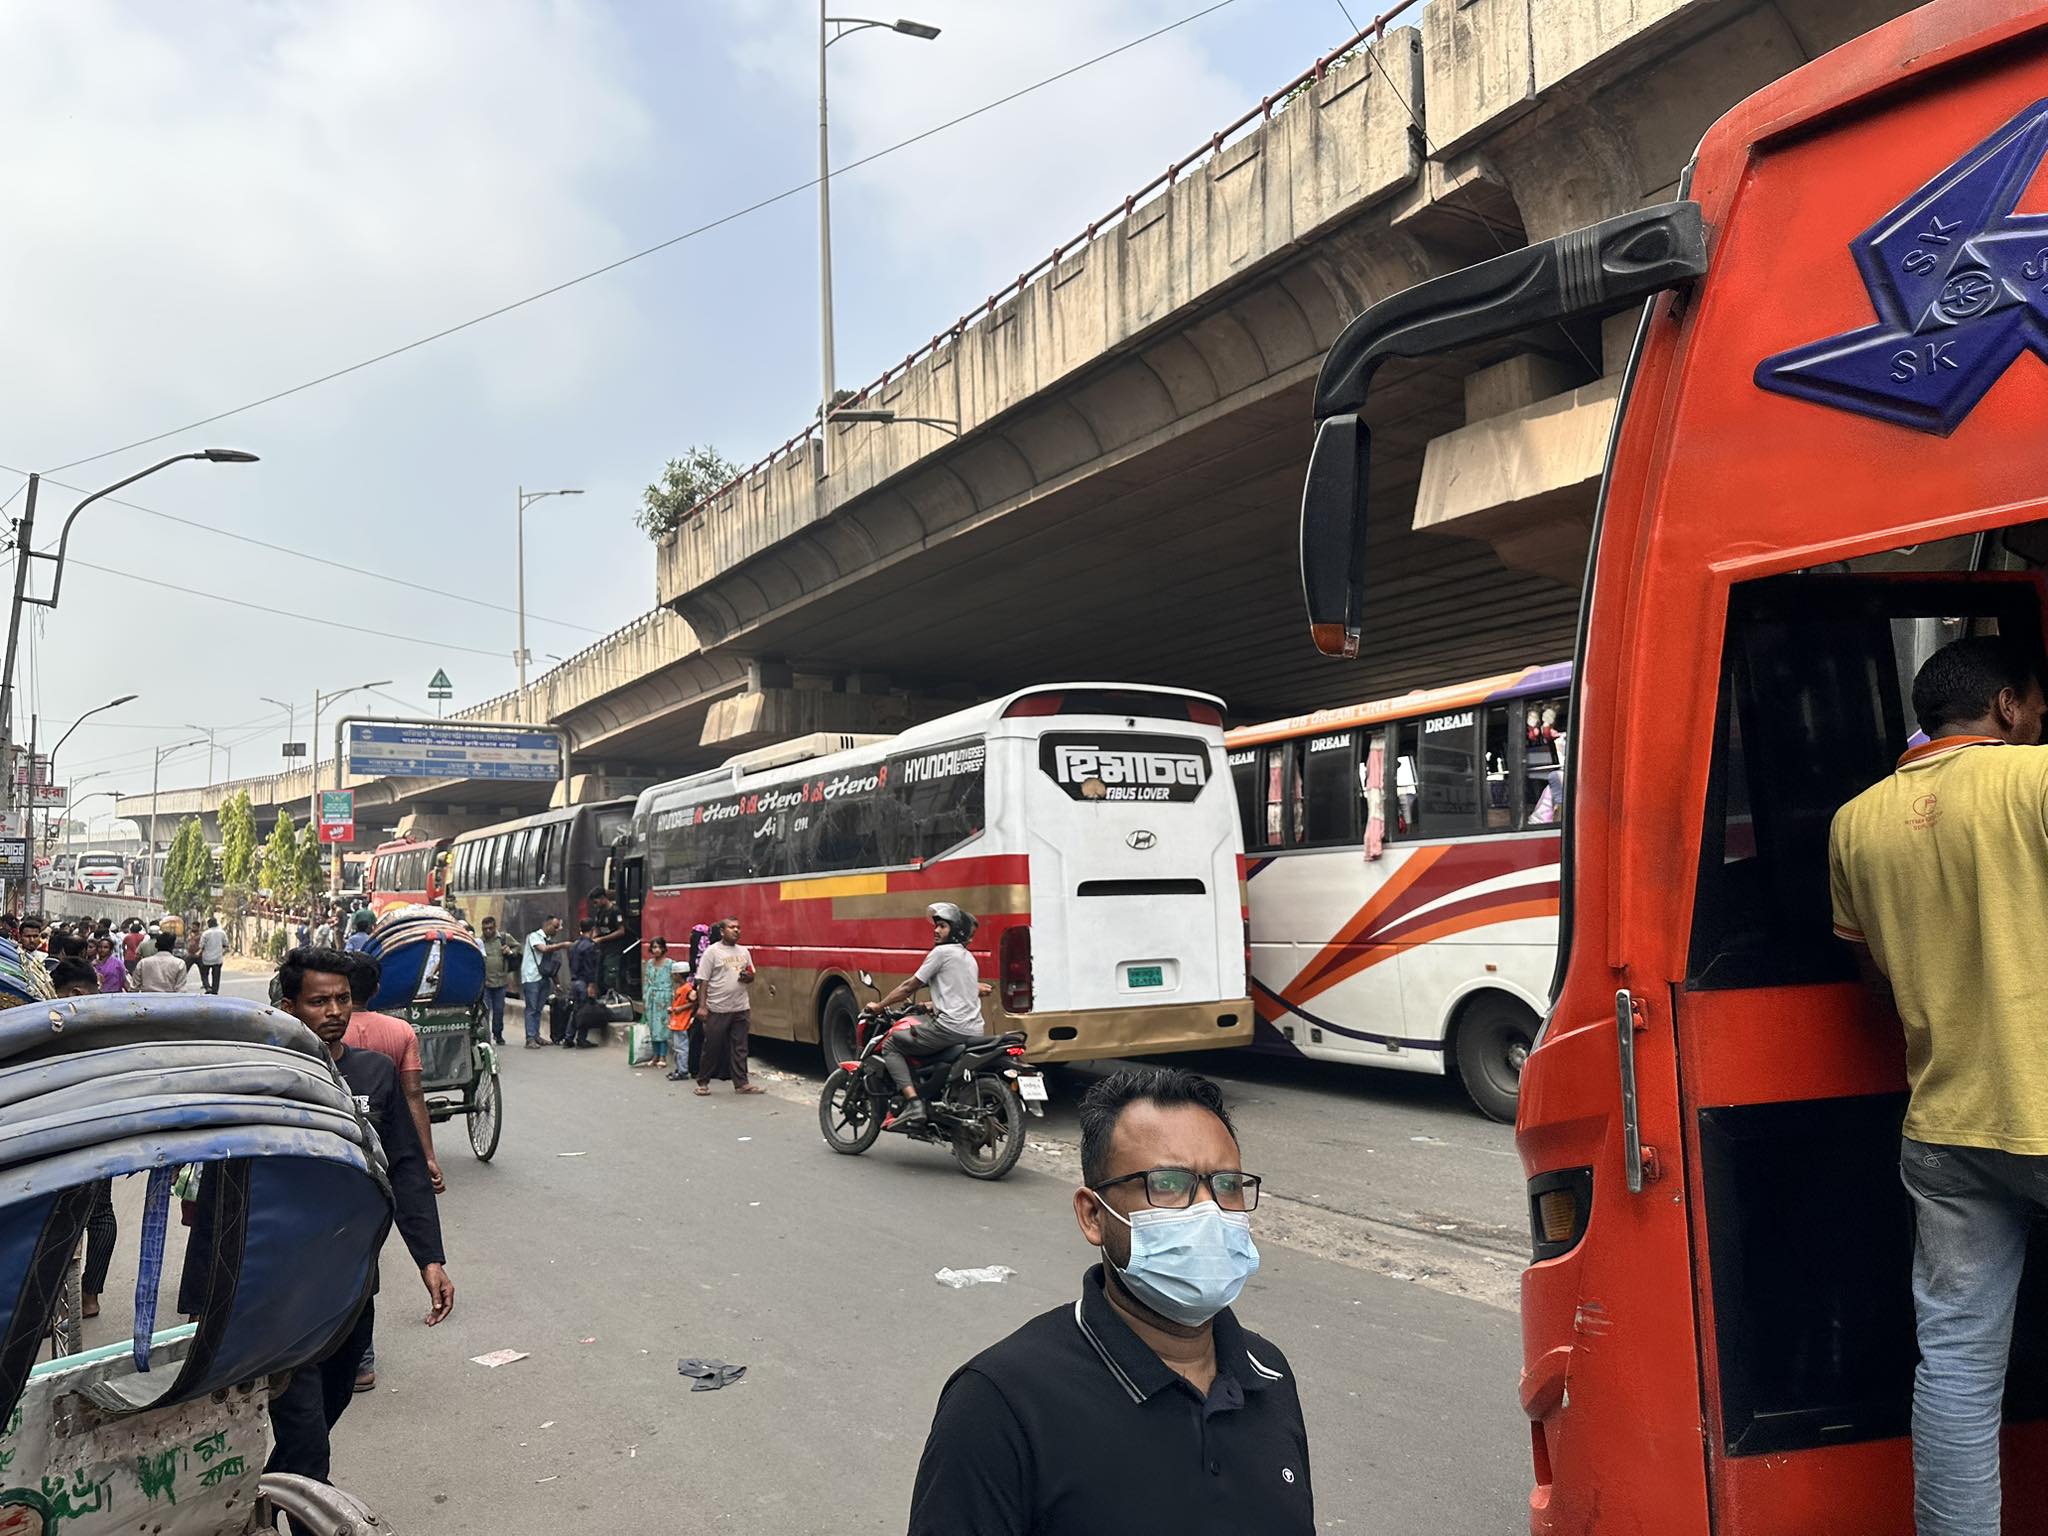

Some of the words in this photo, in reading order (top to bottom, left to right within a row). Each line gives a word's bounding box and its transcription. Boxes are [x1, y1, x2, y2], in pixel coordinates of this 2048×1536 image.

[1902, 215, 1963, 276] SK
[1890, 341, 1959, 384] SK
[1425, 712, 1474, 733] DREAM
[1228, 751, 1256, 766] REAM
[1311, 734, 1350, 752] DREAM
[904, 750, 957, 783] HYUNDAI
[1055, 745, 1205, 785] হিমাচল
[702, 803, 739, 823] Hero
[757, 790, 802, 813] Hero
[824, 774, 879, 799] Hero
[1138, 788, 1169, 800] LOVER
